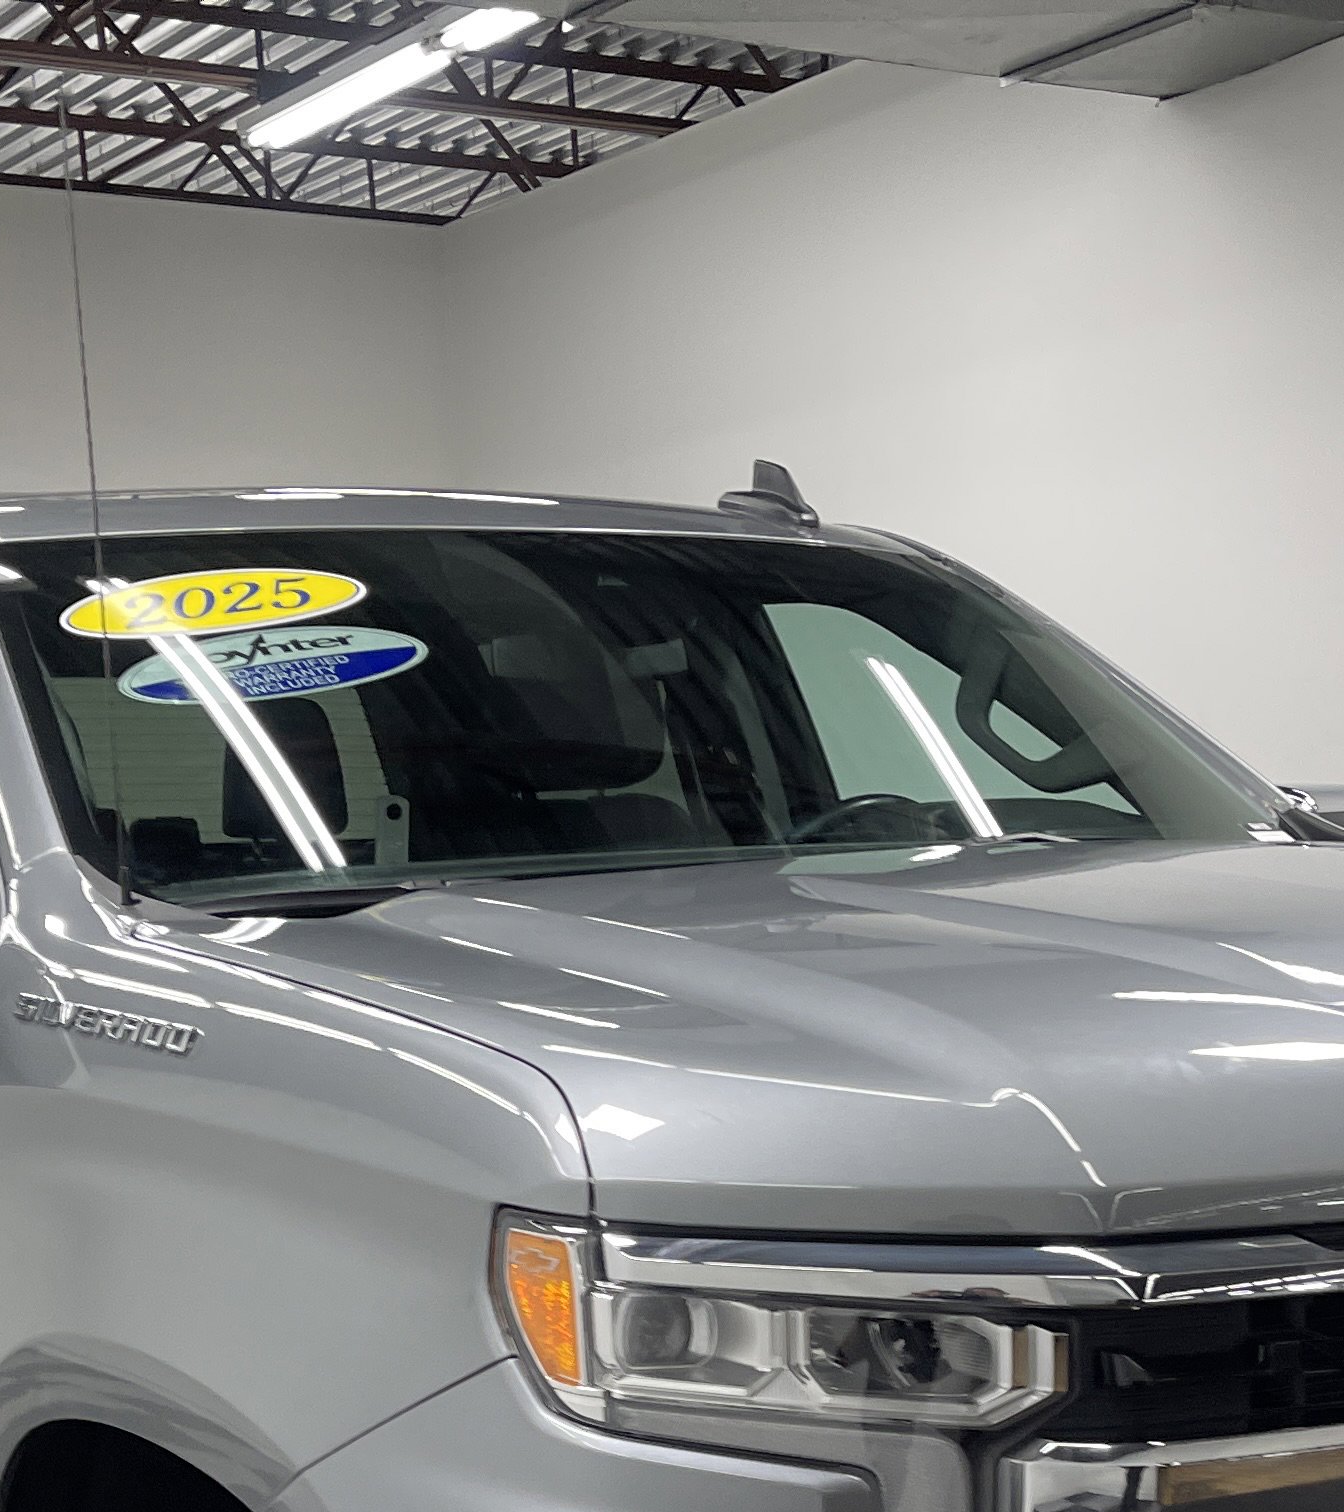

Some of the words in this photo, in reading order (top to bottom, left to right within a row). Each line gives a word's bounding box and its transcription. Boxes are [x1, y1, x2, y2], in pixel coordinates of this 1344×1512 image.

[124, 577, 313, 631] 2025
[208, 633, 354, 665] oynter
[226, 655, 350, 681] RO-CERTIFIED
[234, 666, 337, 689] WARRANTY
[246, 674, 340, 696] INCLUDED
[12, 992, 205, 1058] SILVERADO
